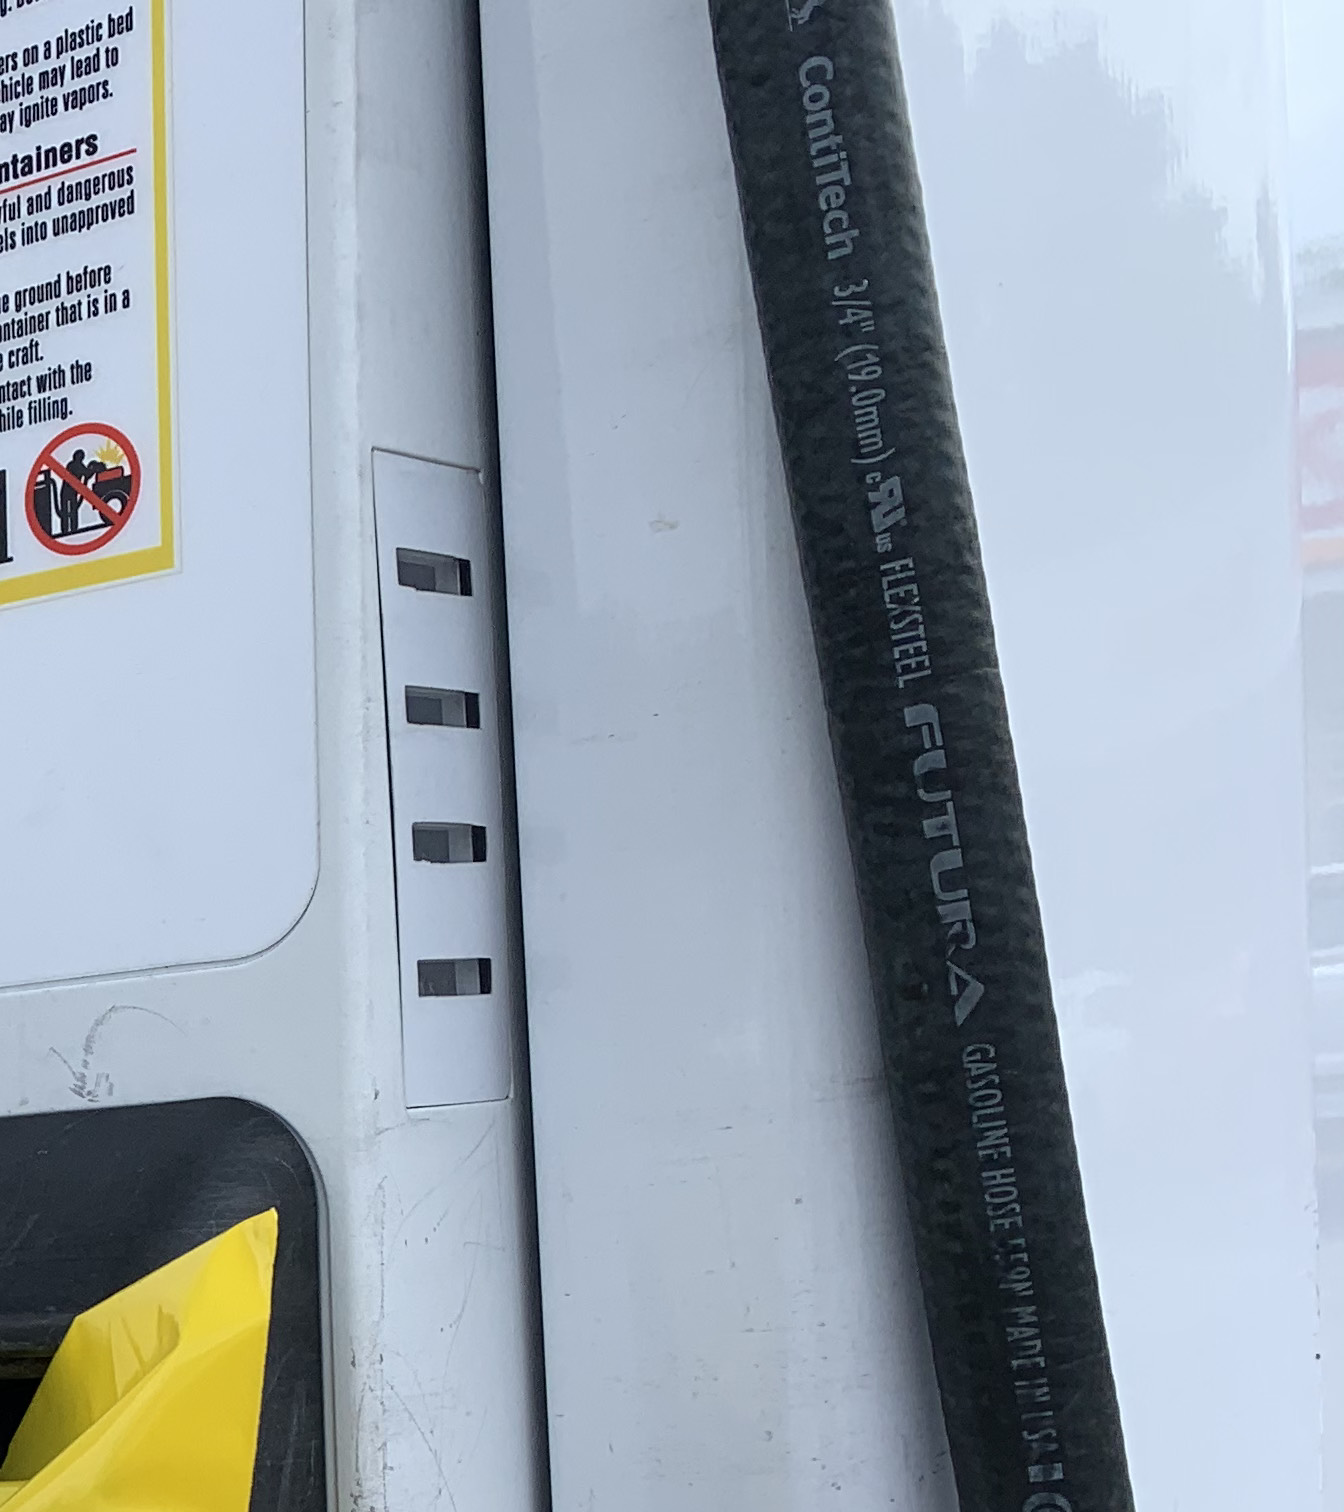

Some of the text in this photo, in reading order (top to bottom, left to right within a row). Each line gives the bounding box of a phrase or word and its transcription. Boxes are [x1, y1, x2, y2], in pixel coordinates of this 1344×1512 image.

[14, 274, 61, 313] ground
[66, 265, 112, 295] before
[798, 55, 861, 261] ContiTech
[834, 343, 897, 466] (19.0mm)
[27, 396, 73, 425] filling.
[36, 366, 66, 394] with
[70, 361, 92, 385] the
[880, 557, 932, 689] FLEXSTEEL
[903, 702, 985, 1027] FUTURA
[962, 1043, 1012, 1164] GASOLINE
[981, 1167, 1023, 1233] HOSE
